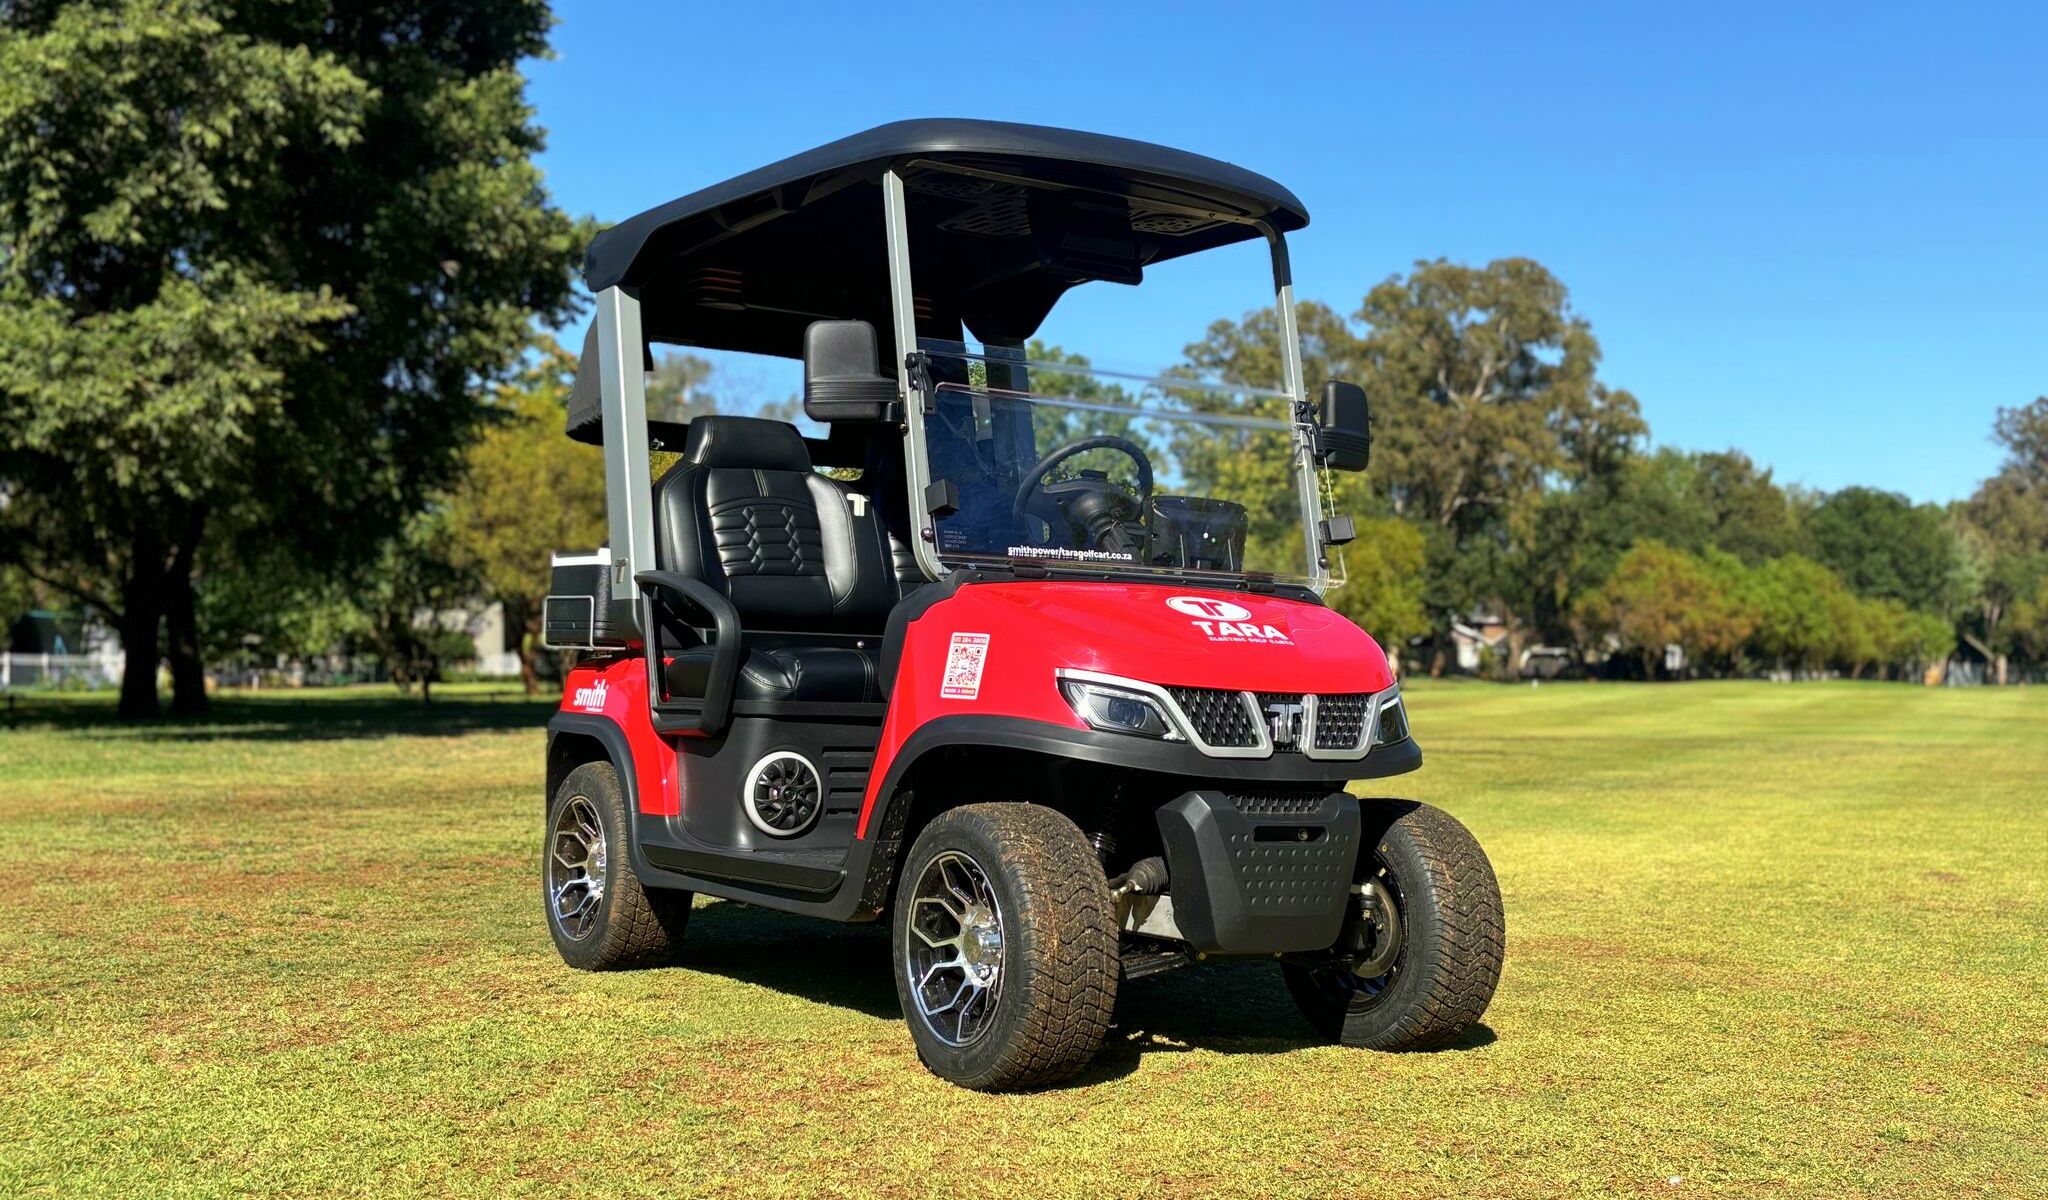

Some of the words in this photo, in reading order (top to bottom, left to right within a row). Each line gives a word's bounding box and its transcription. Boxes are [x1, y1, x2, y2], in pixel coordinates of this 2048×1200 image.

[1008, 545, 1133, 561] smithpower/taragolfcart.co.za
[1191, 621, 1289, 641] TARA
[573, 679, 609, 707] smith
